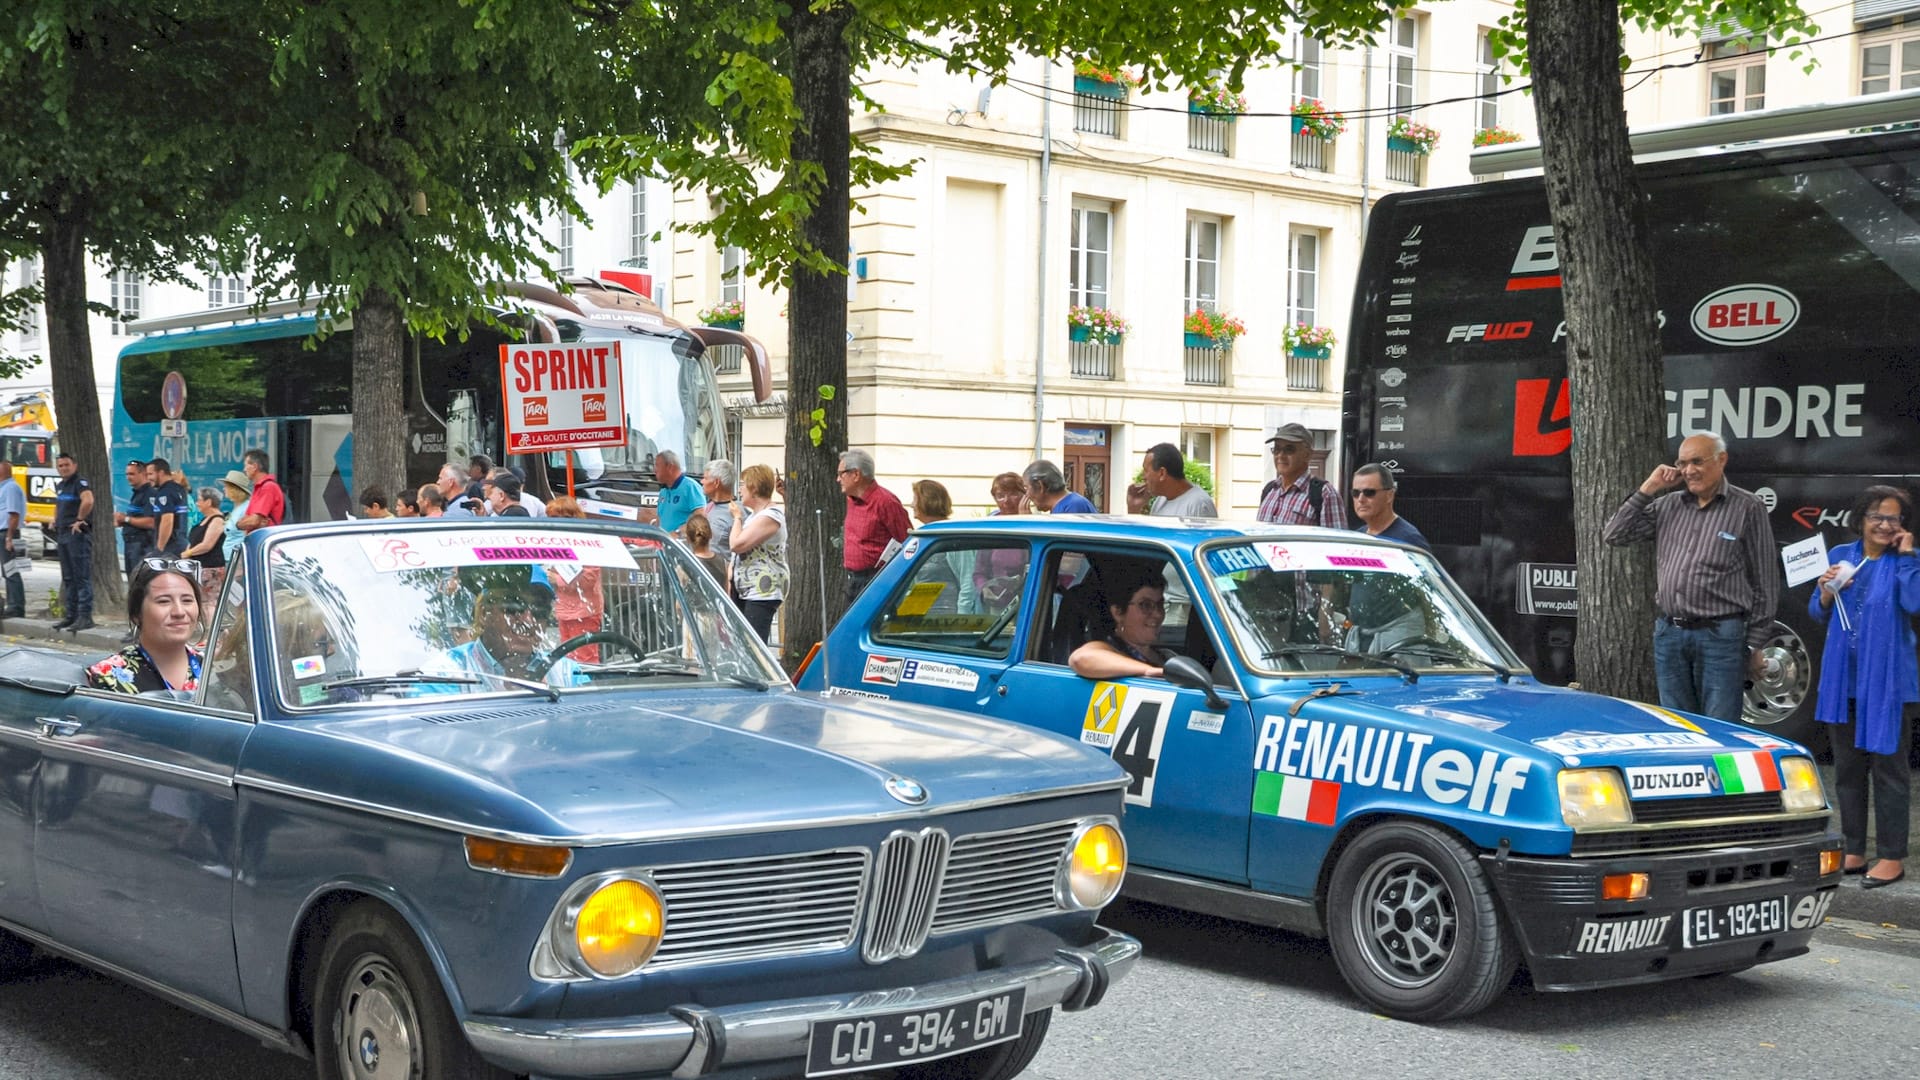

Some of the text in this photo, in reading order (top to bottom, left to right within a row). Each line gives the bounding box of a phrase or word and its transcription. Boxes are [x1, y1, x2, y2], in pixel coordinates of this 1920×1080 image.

[1707, 301, 1782, 328] BELL
[513, 347, 609, 393] SPRINT
[523, 397, 605, 416] TARN TARN
[153, 433, 191, 463] AGR
[195, 432, 215, 464] LA
[532, 430, 614, 443] LA ROUTE D'OCCITANIE
[459, 536, 511, 546] ROUTE
[515, 535, 605, 549] D'OCCITANIE
[479, 547, 574, 560] CARAVANE
[868, 663, 898, 676] CHAMPION
[1084, 732, 1110, 744] RENAULT
[1112, 701, 1162, 797] 4
[1254, 714, 1531, 817] RENAULT elf
[1631, 772, 1706, 790] DUNLOP
[1695, 899, 1780, 941] EL-192-EQ
[1789, 892, 1836, 929] elf
[1576, 915, 1672, 953] RENAULT
[829, 995, 1010, 1065] CQ-394-GM
